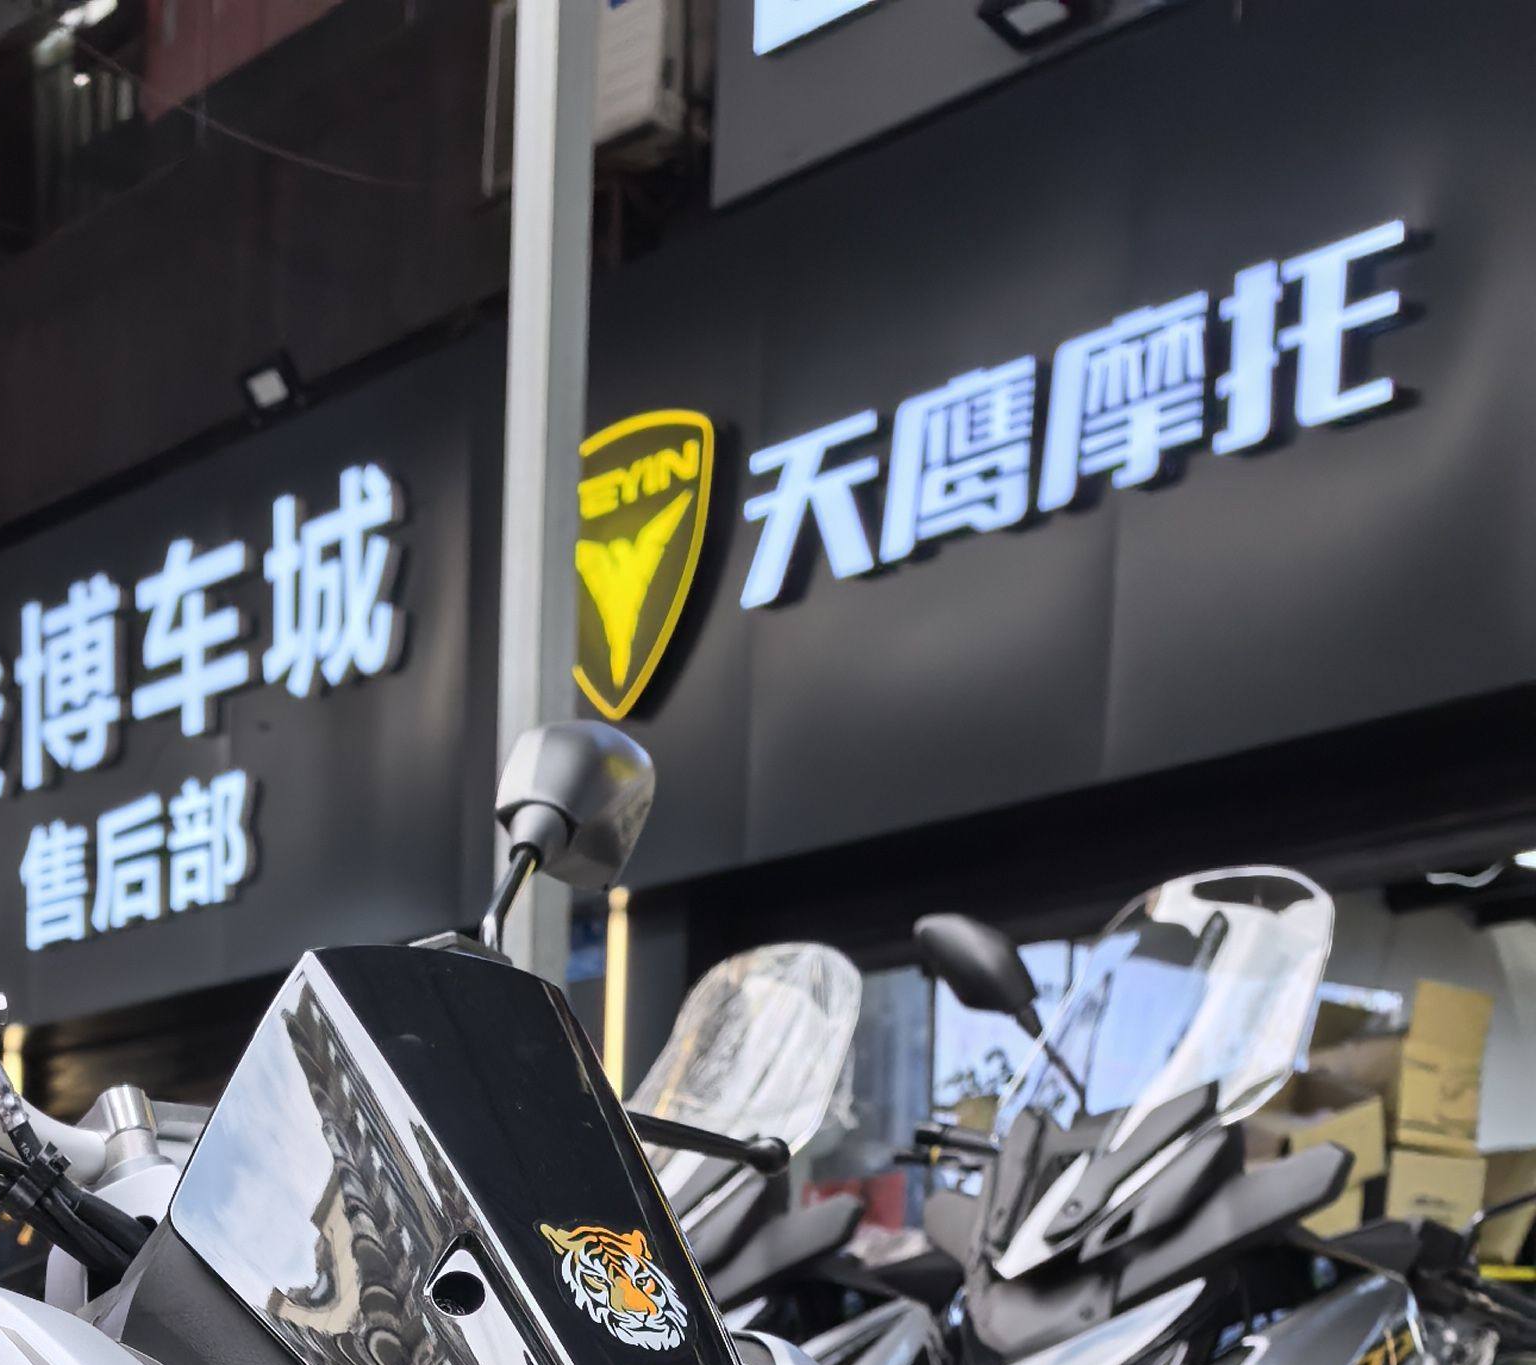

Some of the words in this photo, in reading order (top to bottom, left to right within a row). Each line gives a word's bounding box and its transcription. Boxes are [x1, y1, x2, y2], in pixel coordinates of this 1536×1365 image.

[577, 438, 701, 520] EYIN
[740, 219, 1405, 610] 天鹰摩托
[20, 769, 250, 951] 售后部
